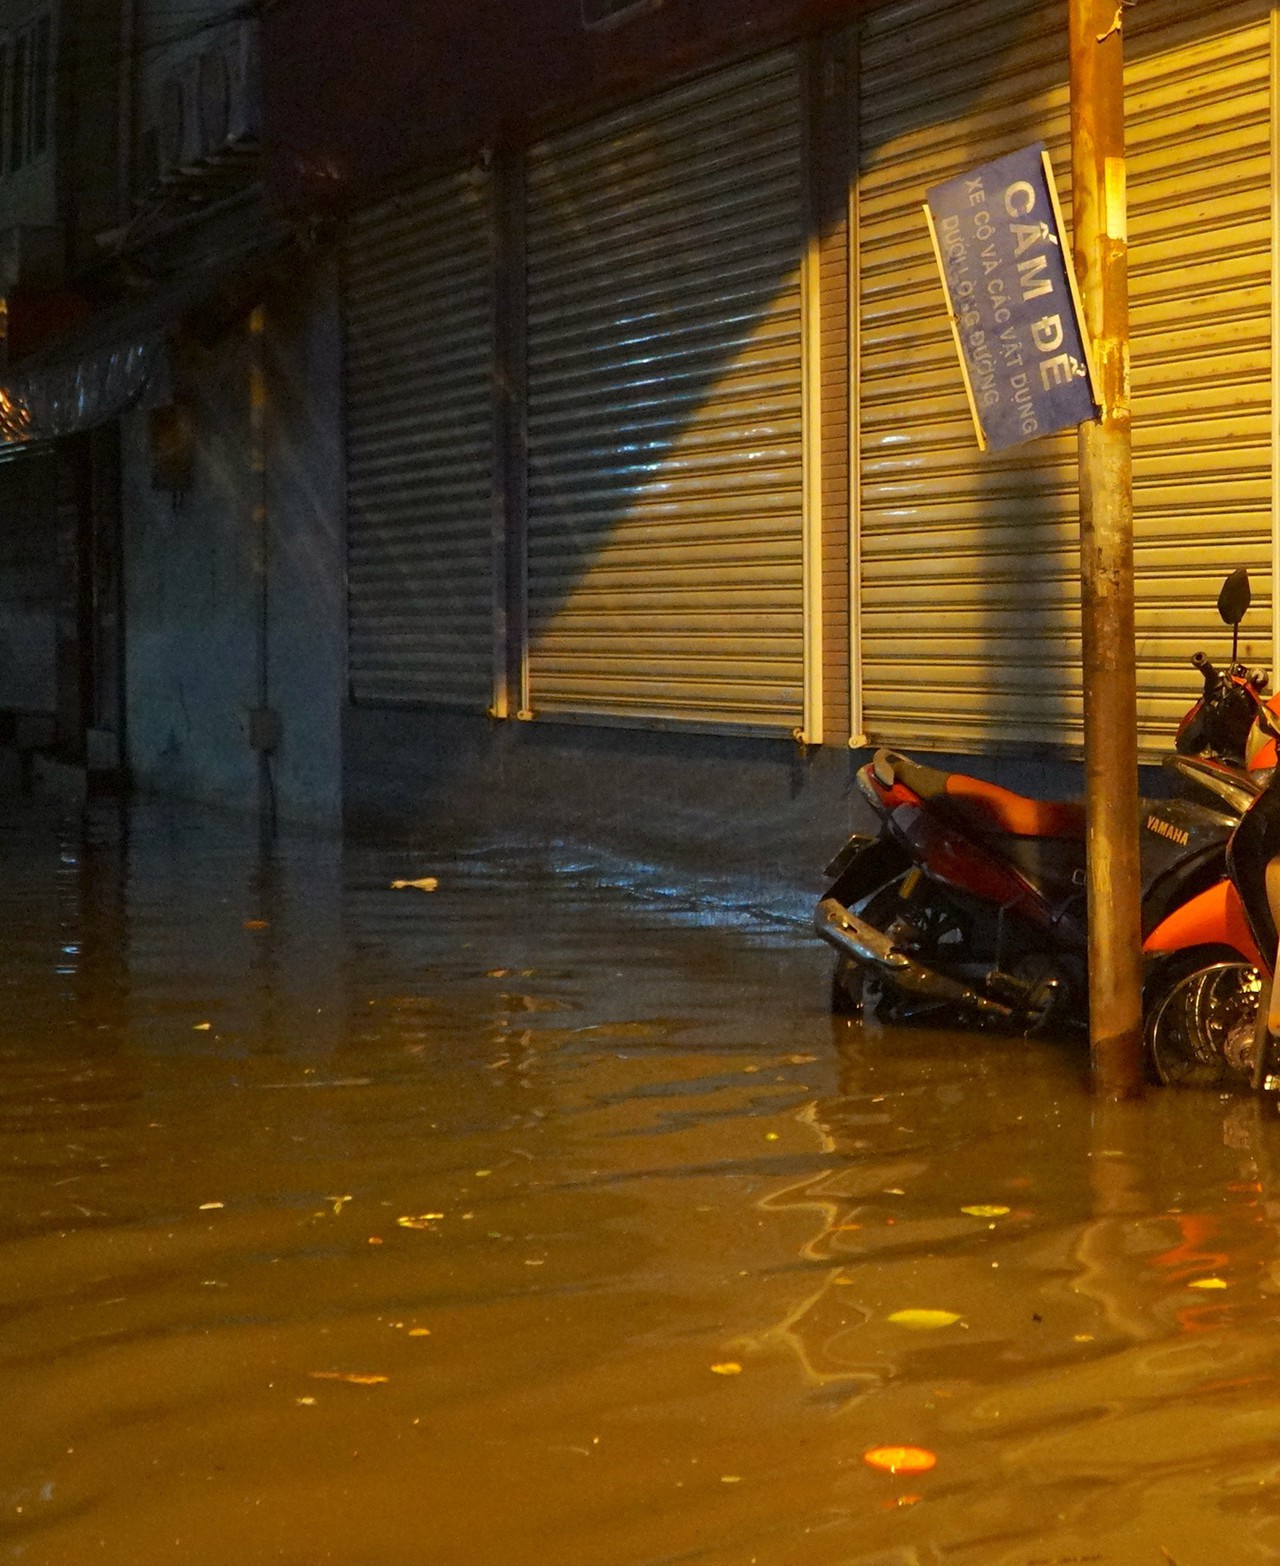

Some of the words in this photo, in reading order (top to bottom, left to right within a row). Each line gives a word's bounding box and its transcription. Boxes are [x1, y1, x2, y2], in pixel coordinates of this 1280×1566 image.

[965, 176, 985, 207] XE
[972, 210, 996, 241] CỘ
[1004, 180, 1058, 300] CẤM
[981, 243, 1002, 275] VÀ
[988, 278, 1012, 324] CÁC
[999, 326, 1024, 368] VẬT
[1030, 313, 1086, 391] ĐỂ
[1011, 372, 1039, 435] DỤNG
[1147, 815, 1189, 846] YAMAHA
